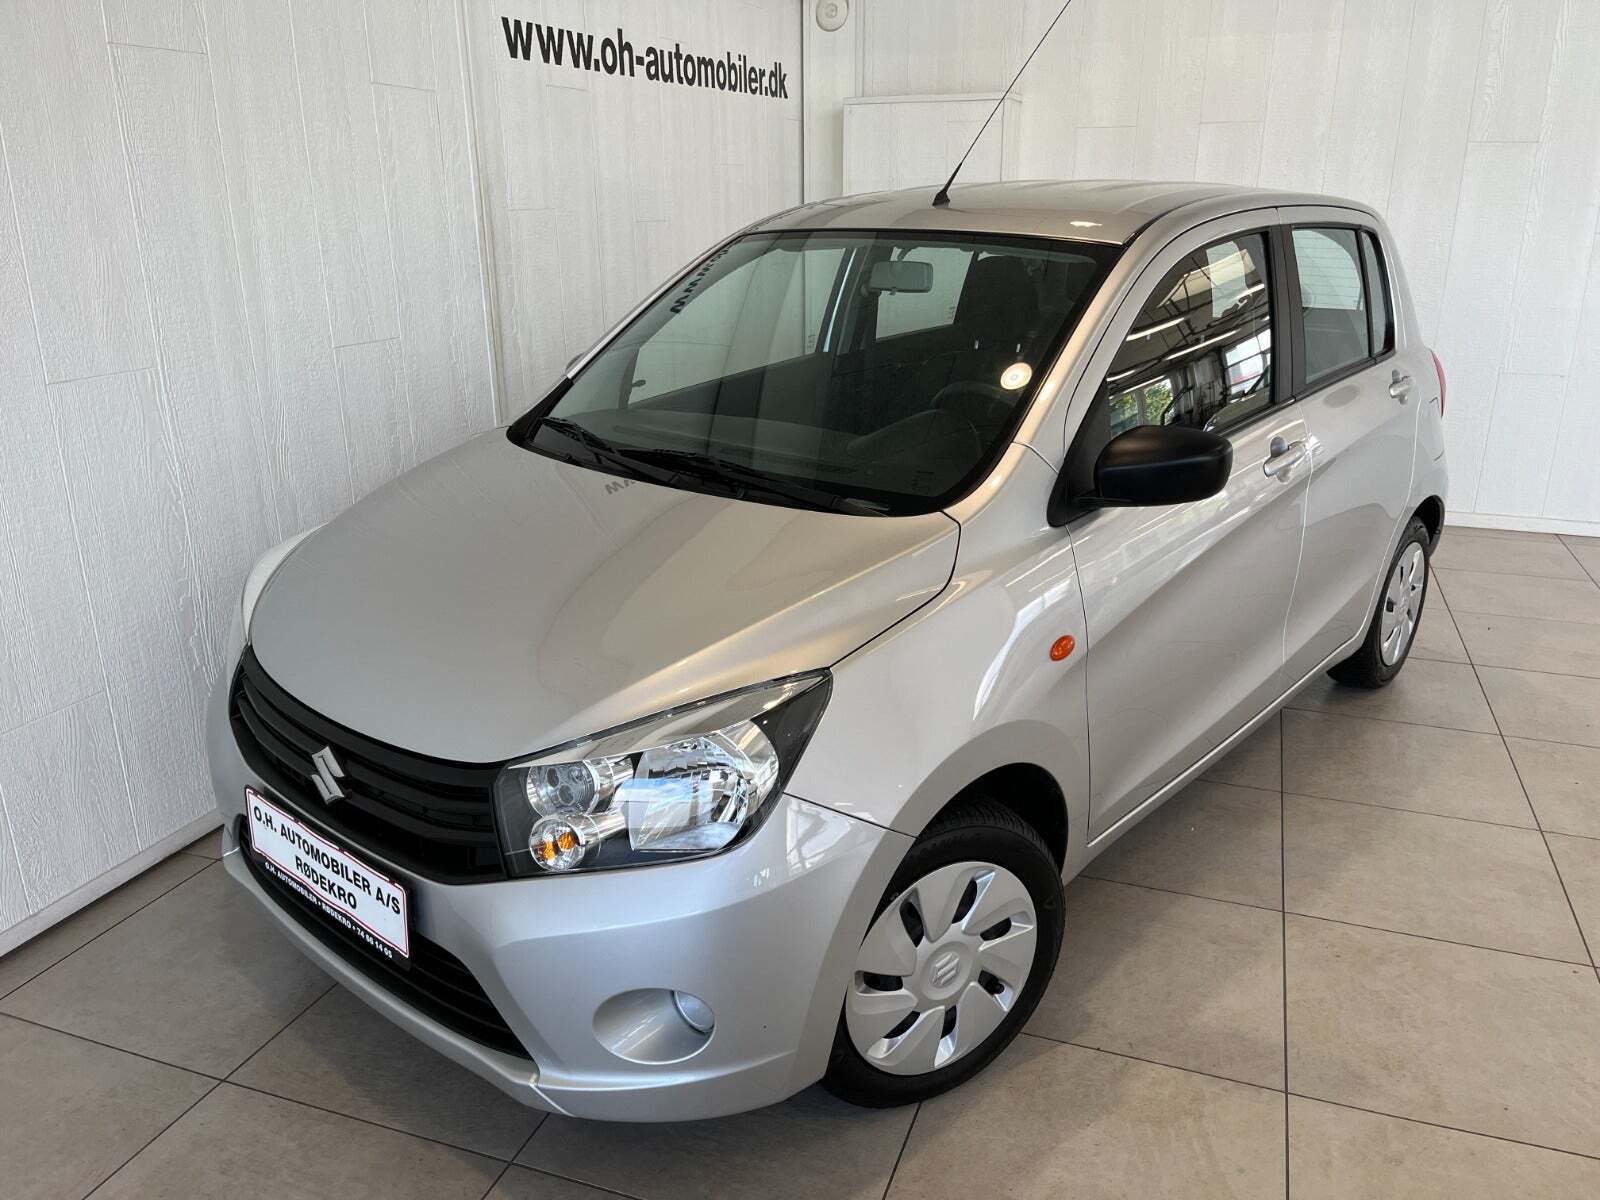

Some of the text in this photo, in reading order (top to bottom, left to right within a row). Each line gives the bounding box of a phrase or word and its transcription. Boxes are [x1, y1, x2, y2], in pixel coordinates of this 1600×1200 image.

[501, 16, 789, 99] www.oh-automobiler.dk
[253, 806, 401, 915] O.H. AUTOMOBILER A/S
[295, 855, 357, 910] RØDEKRO
